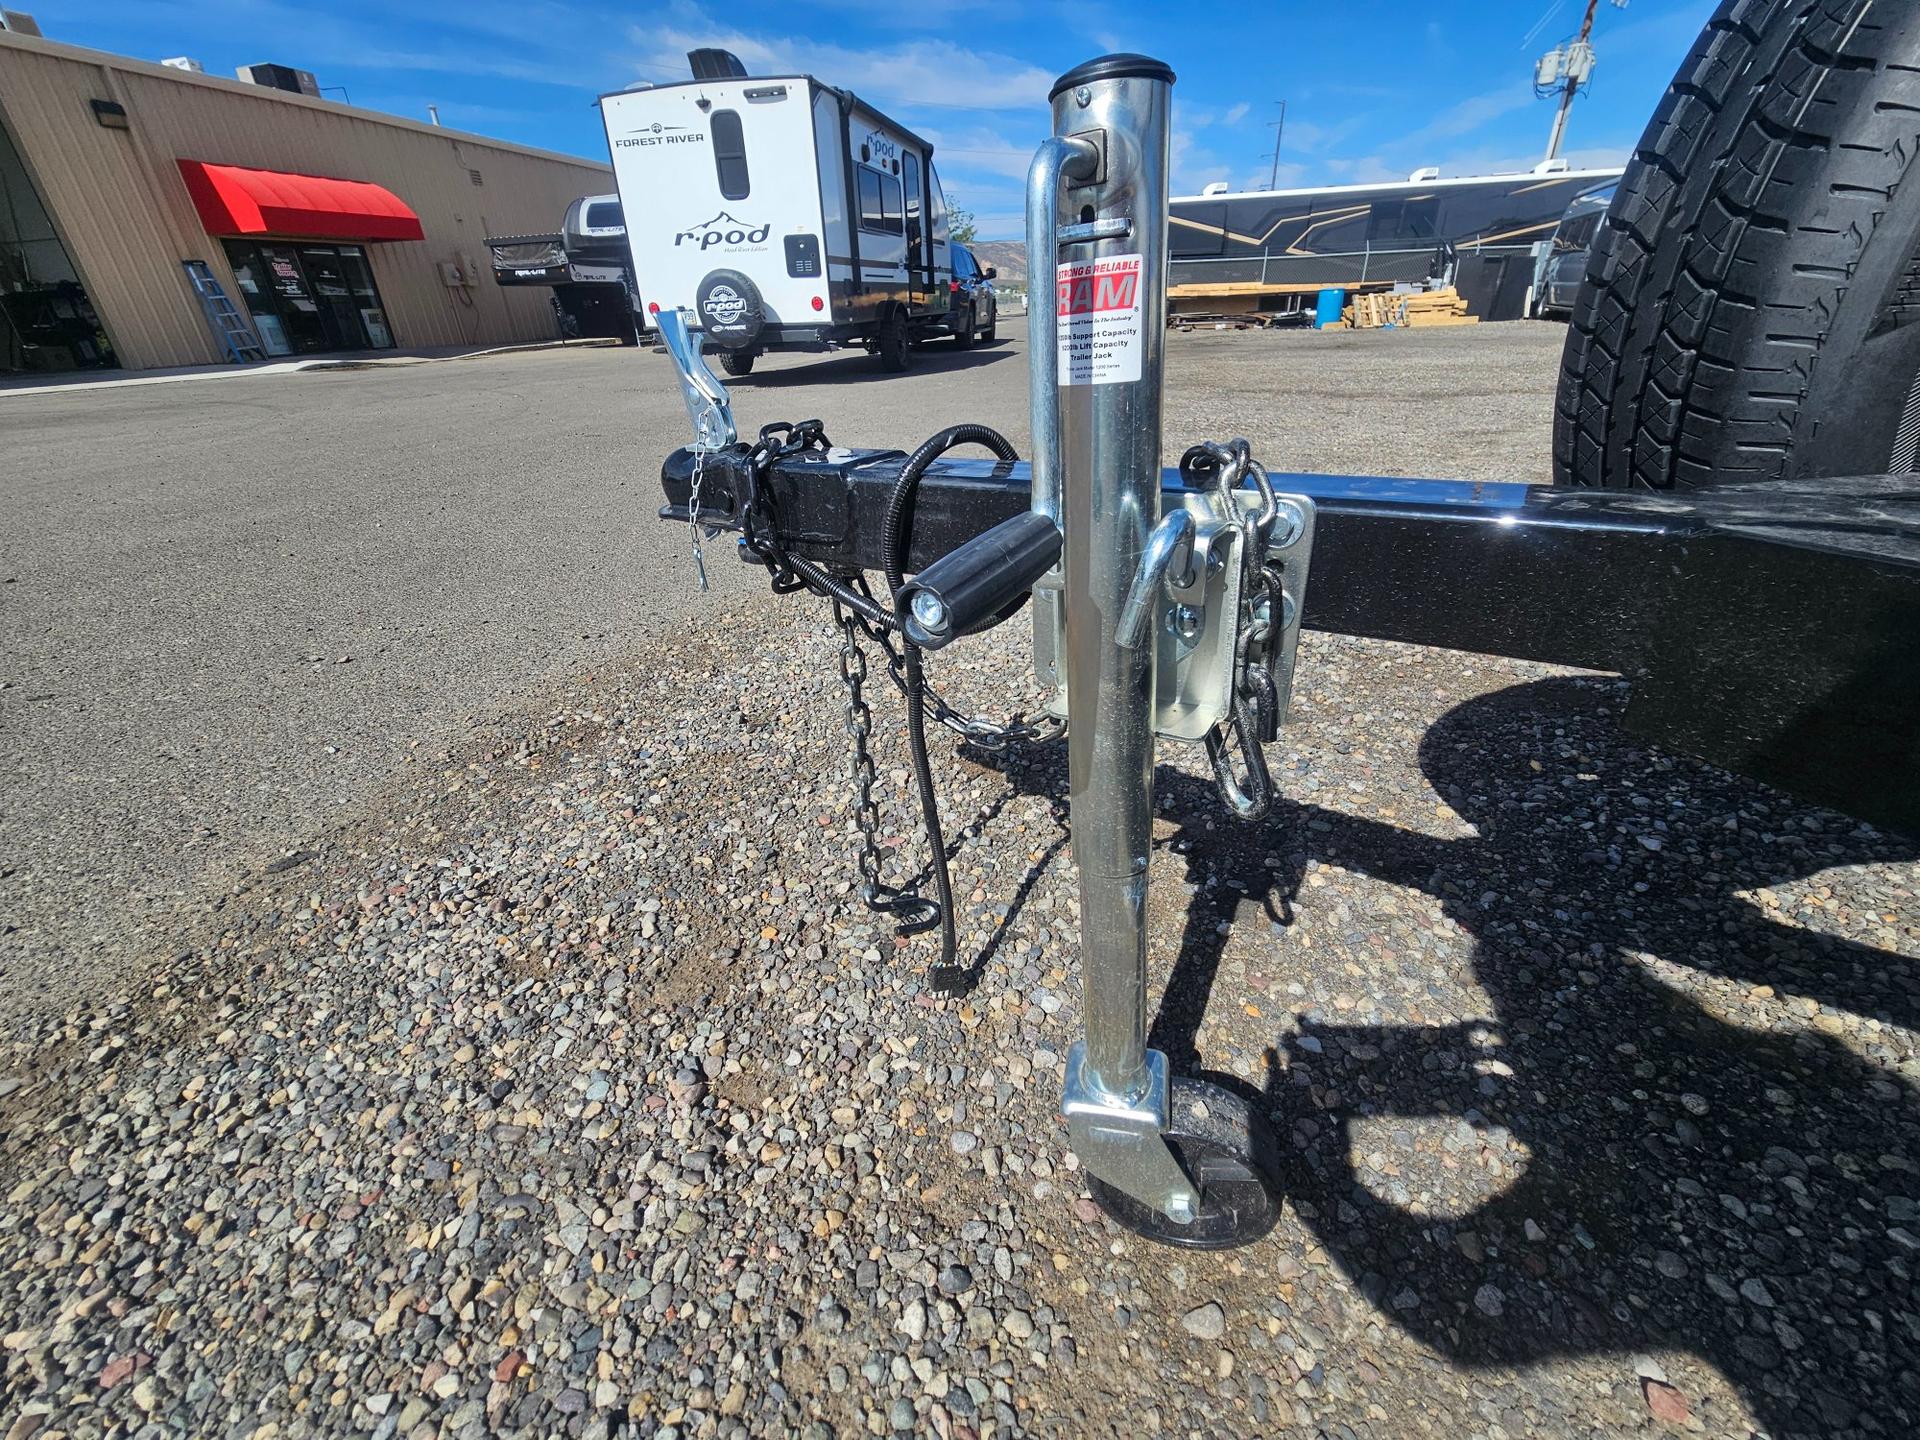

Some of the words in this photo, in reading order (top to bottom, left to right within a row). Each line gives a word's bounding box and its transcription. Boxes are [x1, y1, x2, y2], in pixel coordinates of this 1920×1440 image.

[615, 136, 663, 148] FOREST
[666, 133, 704, 144] RIVER
[1058, 266, 1084, 280] STRONG
[1085, 265, 1092, 274] &
[1093, 260, 1140, 273] RELIABLE
[1059, 274, 1135, 313] RAM
[1072, 332, 1101, 341] Support
[1102, 328, 1138, 338] Capacity
[1093, 340, 1129, 349] Capacity
